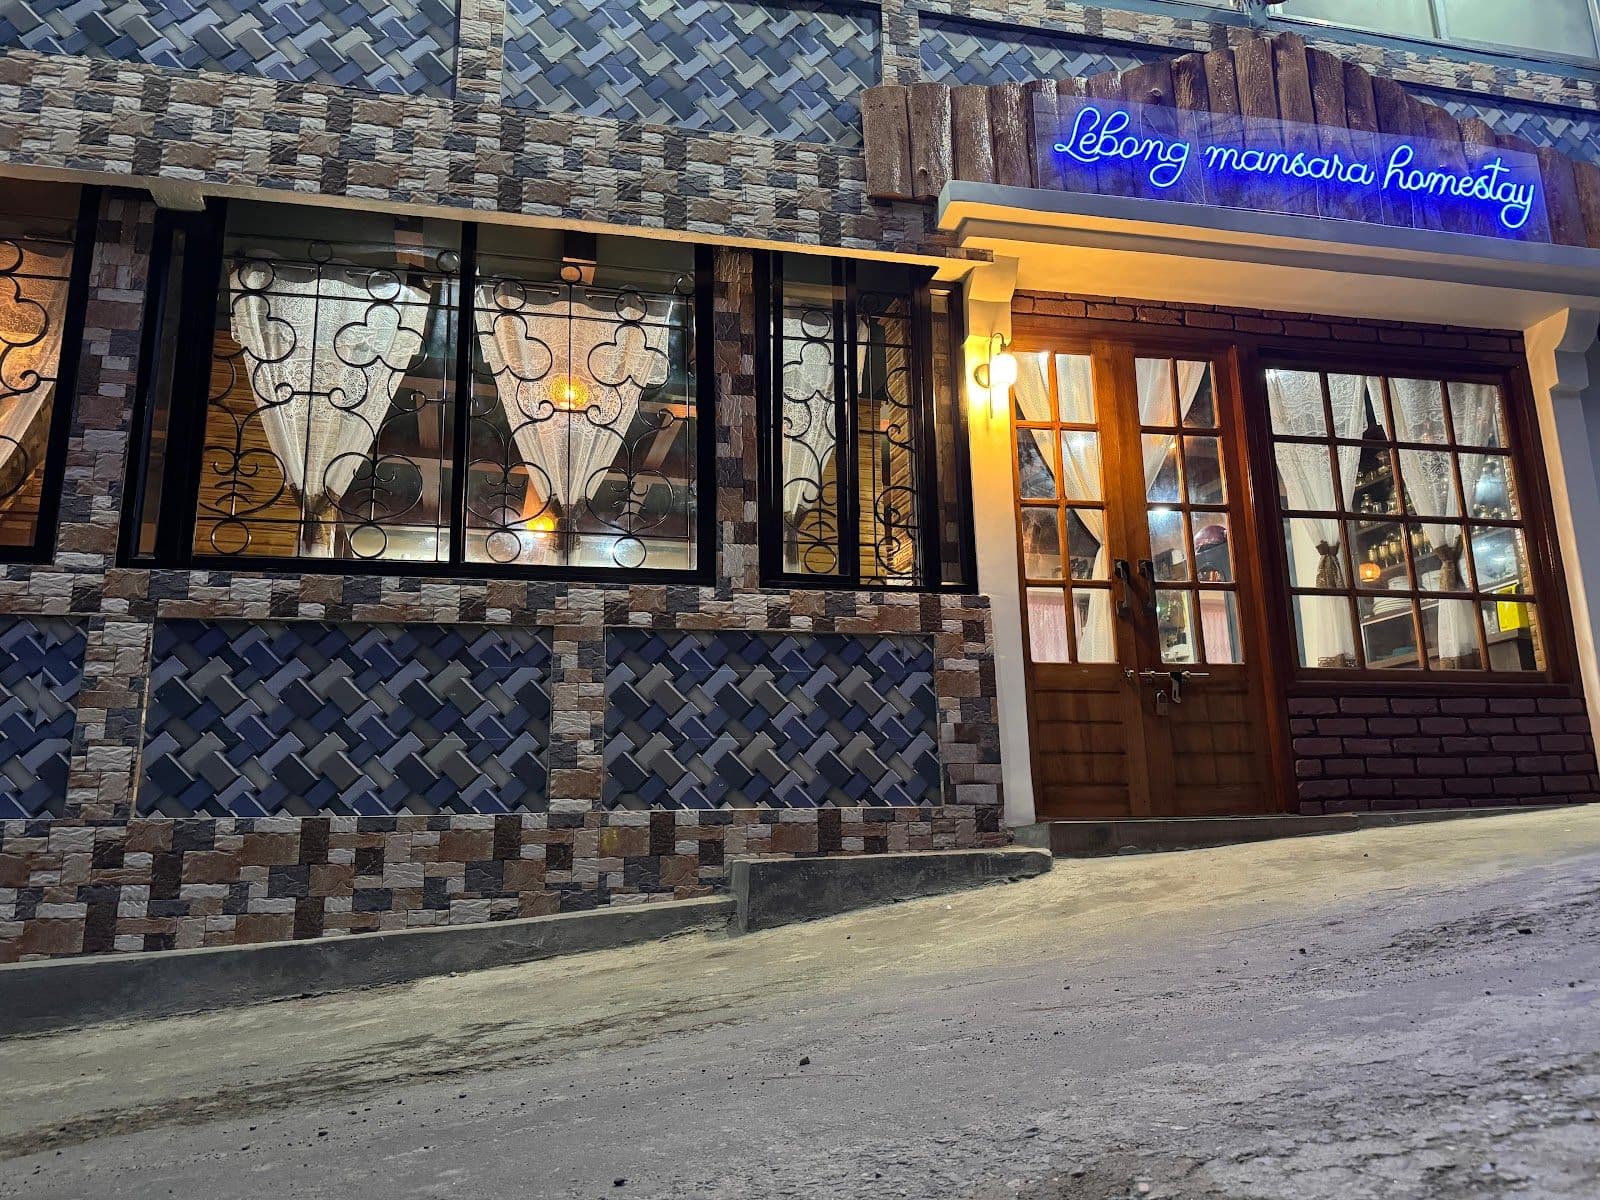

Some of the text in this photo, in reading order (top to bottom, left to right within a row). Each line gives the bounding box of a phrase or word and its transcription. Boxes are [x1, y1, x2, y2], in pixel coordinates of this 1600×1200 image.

[1053, 106, 1535, 229] Lebong mansara homestay
